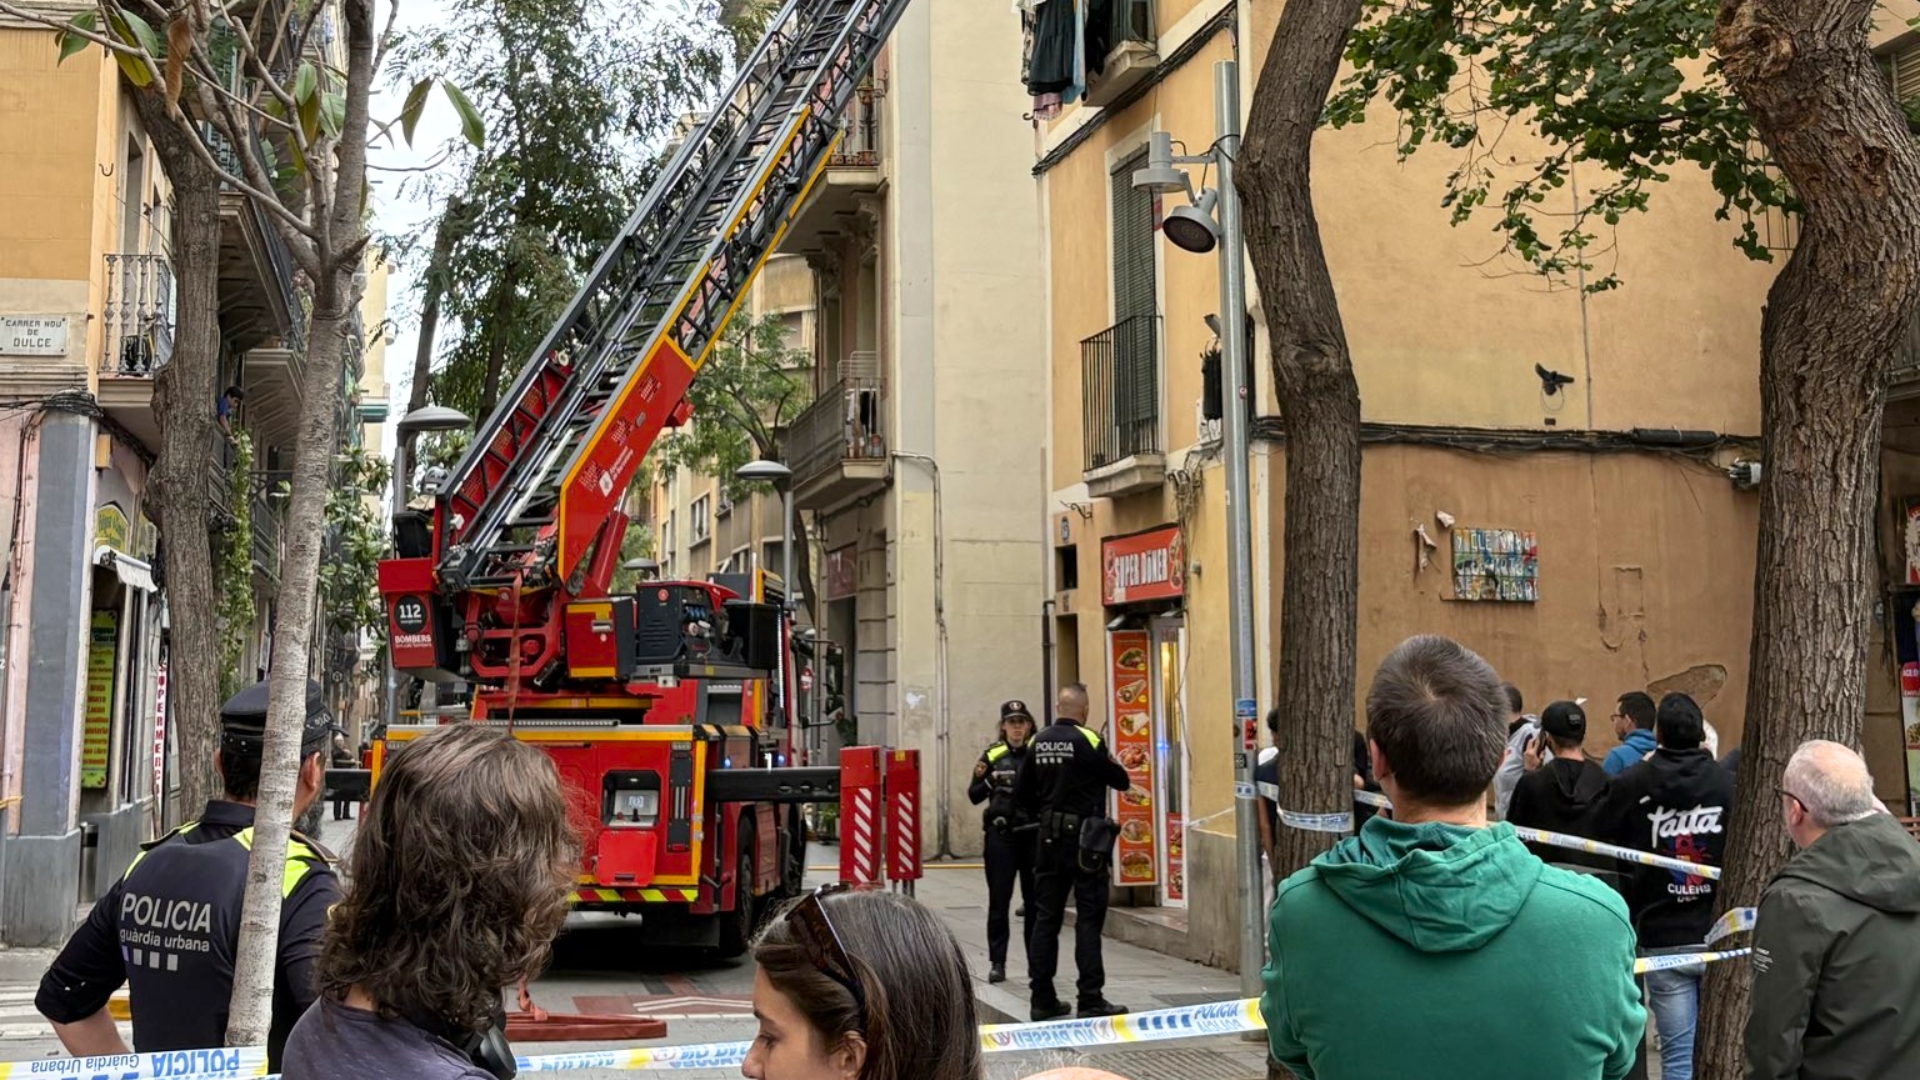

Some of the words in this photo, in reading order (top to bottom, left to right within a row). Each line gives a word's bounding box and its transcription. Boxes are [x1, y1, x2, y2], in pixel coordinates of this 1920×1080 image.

[5, 319, 41, 327] CARRER
[44, 320, 62, 328] NOU
[27, 328, 39, 336] DE
[13, 338, 51, 348] DULCE
[1114, 553, 1140, 588] SUPER
[399, 604, 422, 619] 112
[394, 634, 432, 644] BOMBERS
[1035, 742, 1075, 752] POLICIA
[120, 892, 212, 934] POLICIA
[164, 934, 210, 952] urbana
[31, 1059, 81, 1073] Urbana
[86, 1054, 140, 1071] Guàrdia
[152, 1049, 240, 1077] POLICIA
